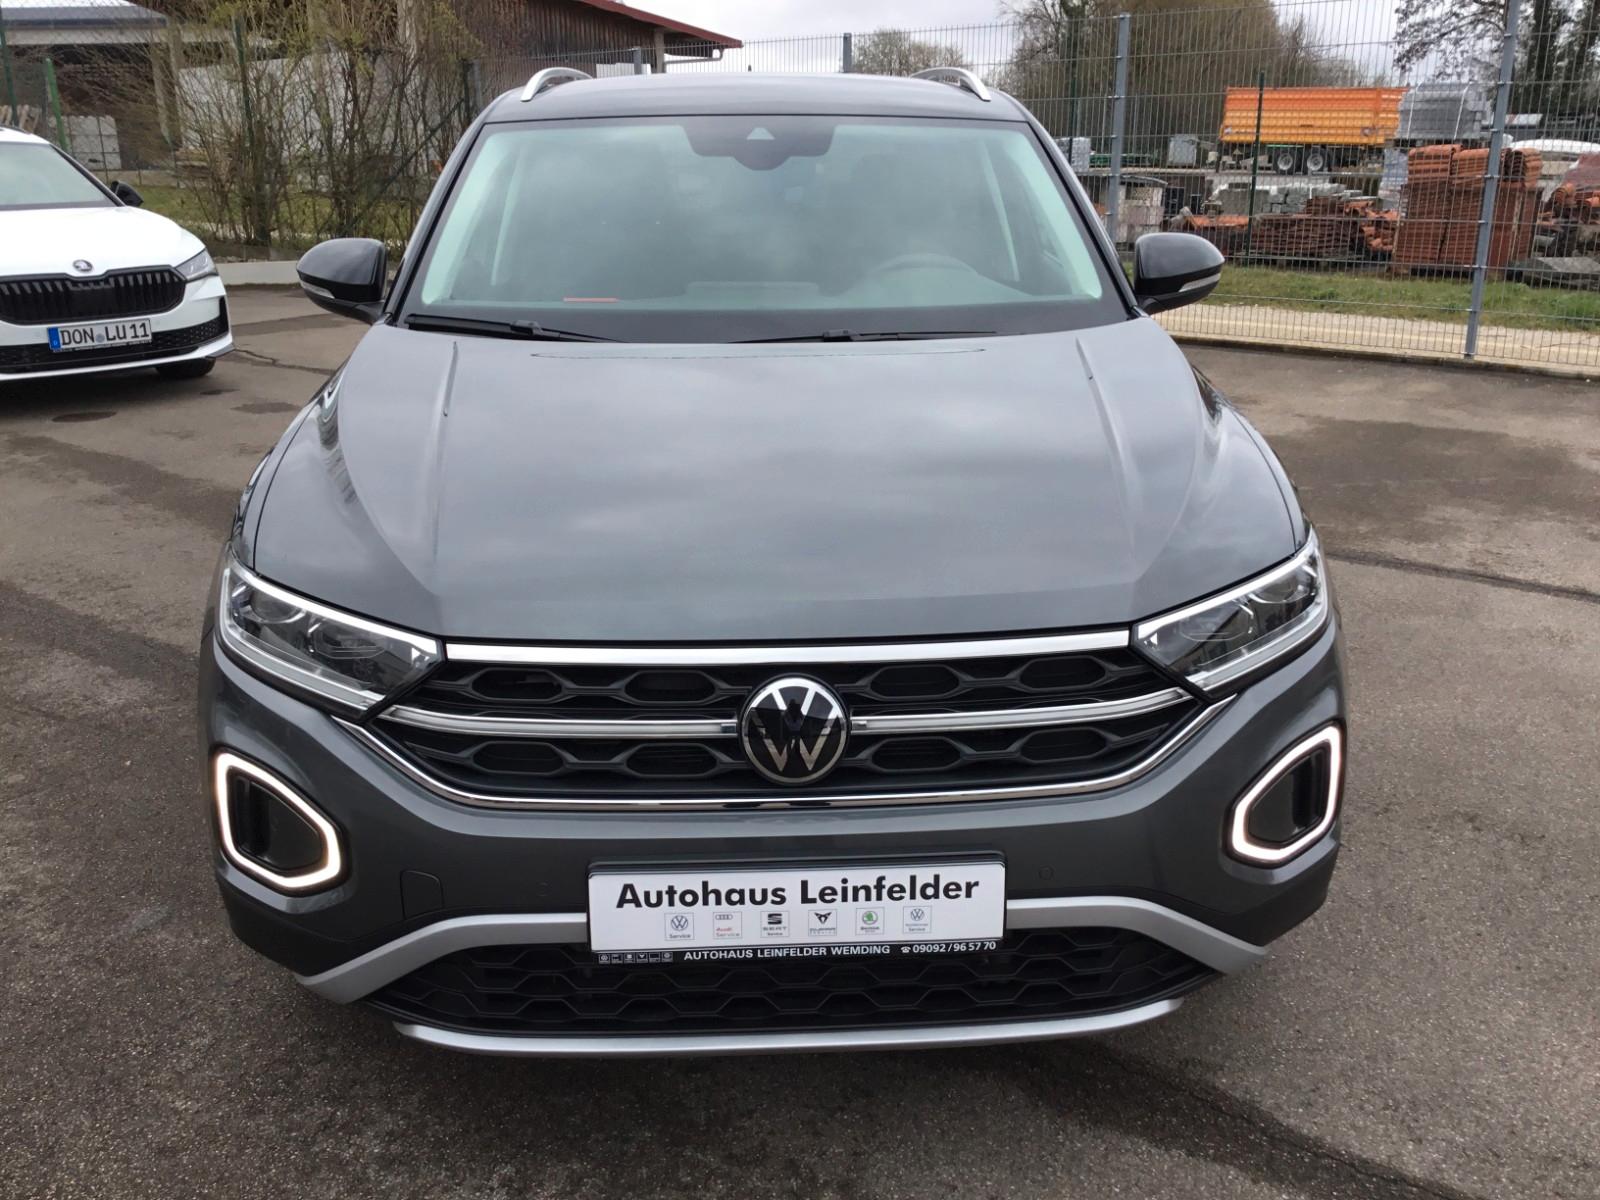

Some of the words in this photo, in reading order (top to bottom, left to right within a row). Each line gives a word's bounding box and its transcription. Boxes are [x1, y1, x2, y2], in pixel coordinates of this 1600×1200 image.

[60, 327, 95, 346] DON
[104, 324, 127, 341] LU
[129, 322, 150, 339] 11
[616, 880, 787, 909] Autohaus
[800, 873, 980, 905] Leinfelder
[683, 949, 754, 961] AUTOHAUS
[757, 947, 828, 958] LEINFELDER
[830, 945, 890, 956] WEMDING
